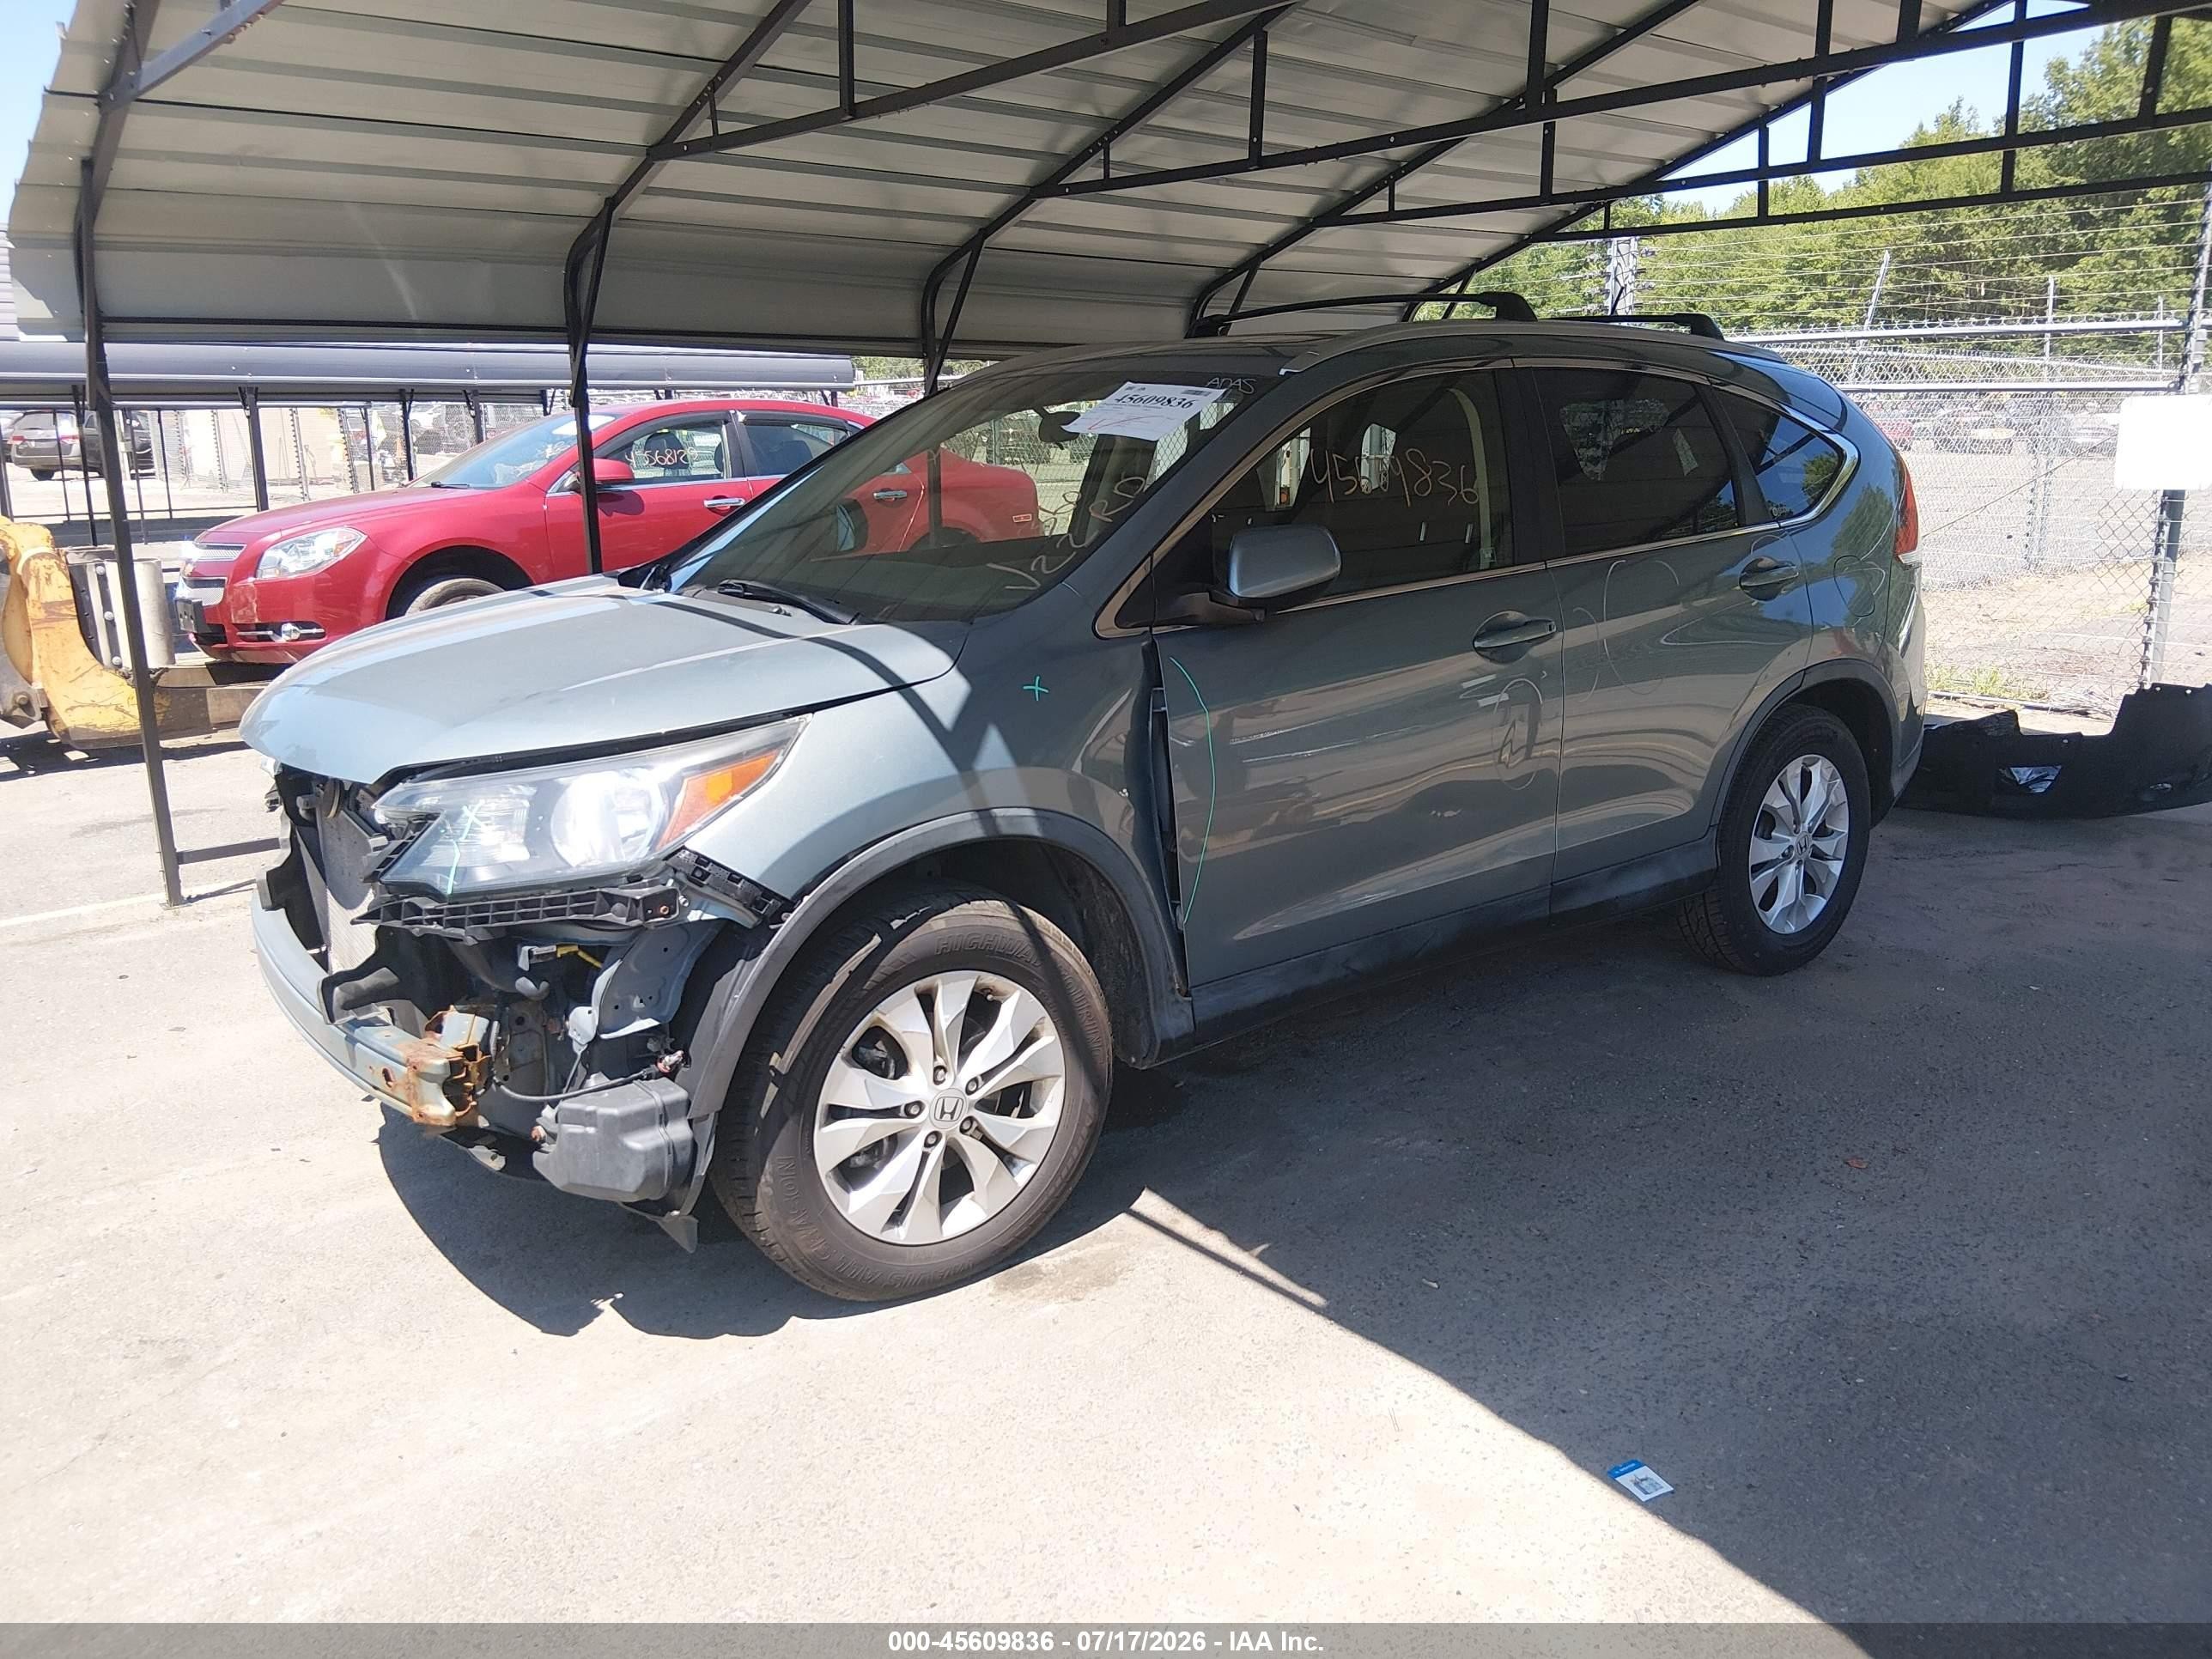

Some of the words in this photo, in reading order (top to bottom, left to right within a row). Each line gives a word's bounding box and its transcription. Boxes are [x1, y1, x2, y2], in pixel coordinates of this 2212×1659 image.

[1206, 376, 1257, 395] ADAS
[1115, 393, 1197, 410] 45609836
[1057, 964, 1104, 1056] OURING
